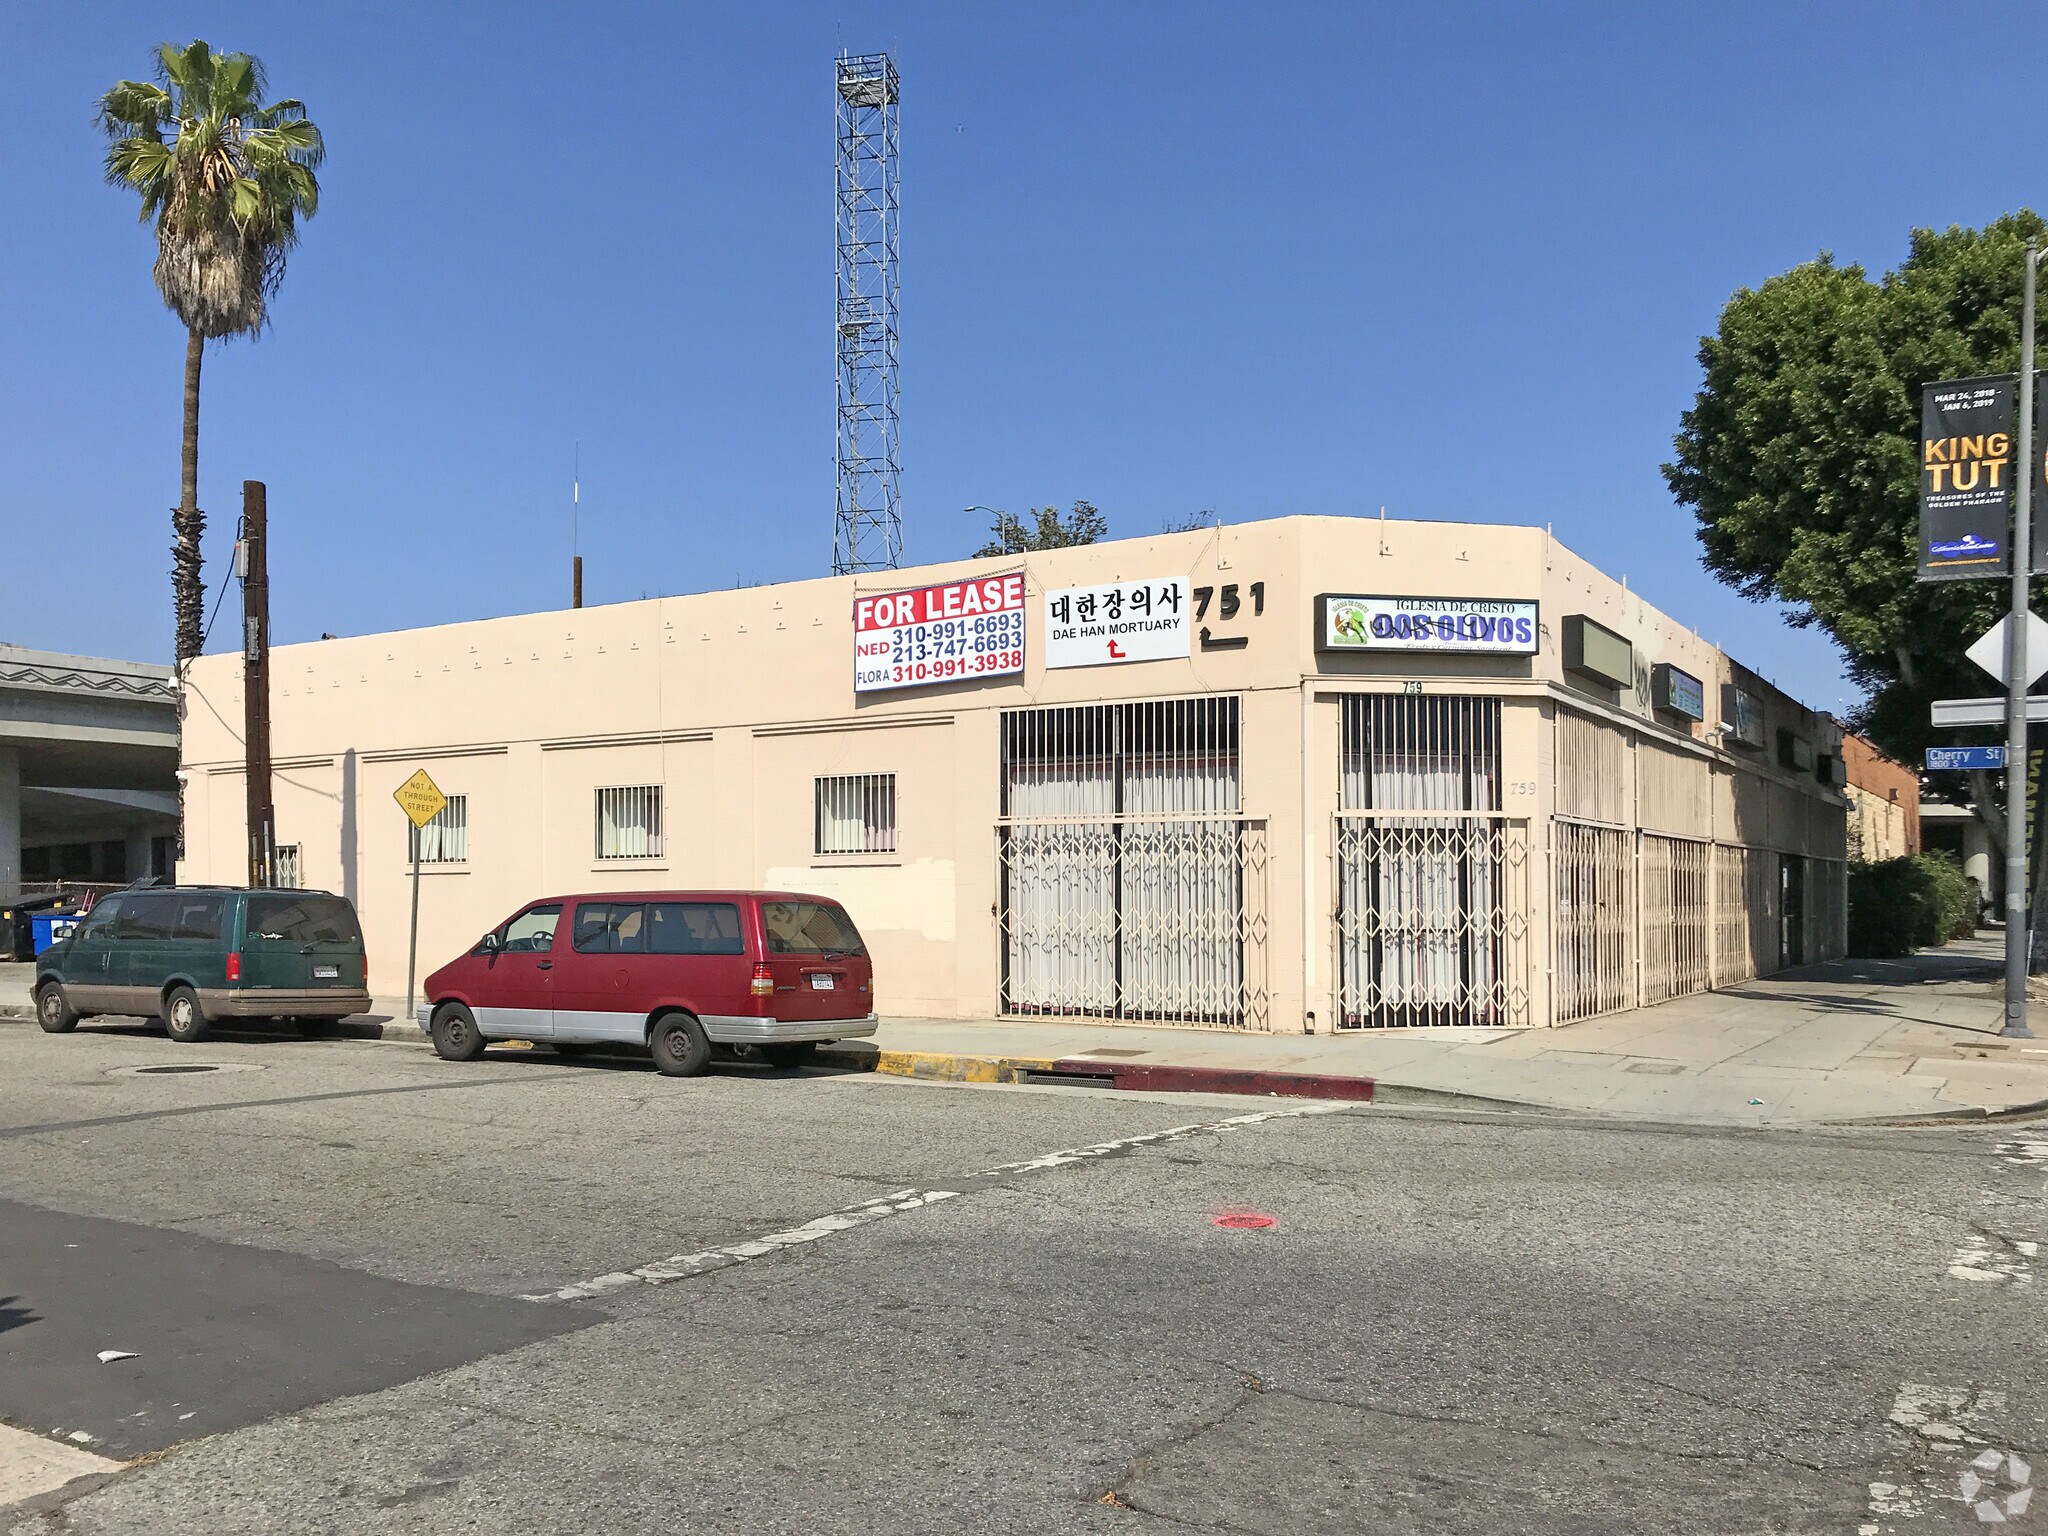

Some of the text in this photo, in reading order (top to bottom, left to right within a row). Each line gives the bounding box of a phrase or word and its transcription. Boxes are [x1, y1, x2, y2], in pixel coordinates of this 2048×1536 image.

[1934, 394, 1956, 403] MAR
[1957, 392, 1972, 401] 24,
[1973, 389, 1996, 398] 2018
[1941, 398, 1995, 412] JAN 6, 2019
[1925, 432, 2009, 463] KING
[1925, 458, 2009, 493] TUT
[1925, 493, 1973, 502] TREASURES
[1928, 498, 2003, 509] GOLDEN PHARAOH
[857, 576, 1023, 631] FOR LEASE
[1050, 582, 1182, 625] 대한장의사
[1193, 582, 1264, 620] 751
[1396, 600, 1515, 614] IGLESIA DE CRISTO
[892, 612, 1023, 646] 310-991-6693
[1053, 618, 1180, 640] DAE HAN MORTUARY
[1374, 613, 1532, 644] DOS OLIVOS
[857, 641, 890, 657] NED
[892, 630, 1023, 664] 213-747-6693
[857, 650, 1023, 684] FLORA 310-991-3938
[1402, 681, 1422, 694] 759
[1929, 748, 2000, 762] Cherry St
[1929, 760, 1949, 768] 1800
[410, 782, 425, 790] NOT
[1510, 781, 1536, 795] 759
[404, 791, 438, 802] THROUGH
[407, 802, 434, 812] STREET
